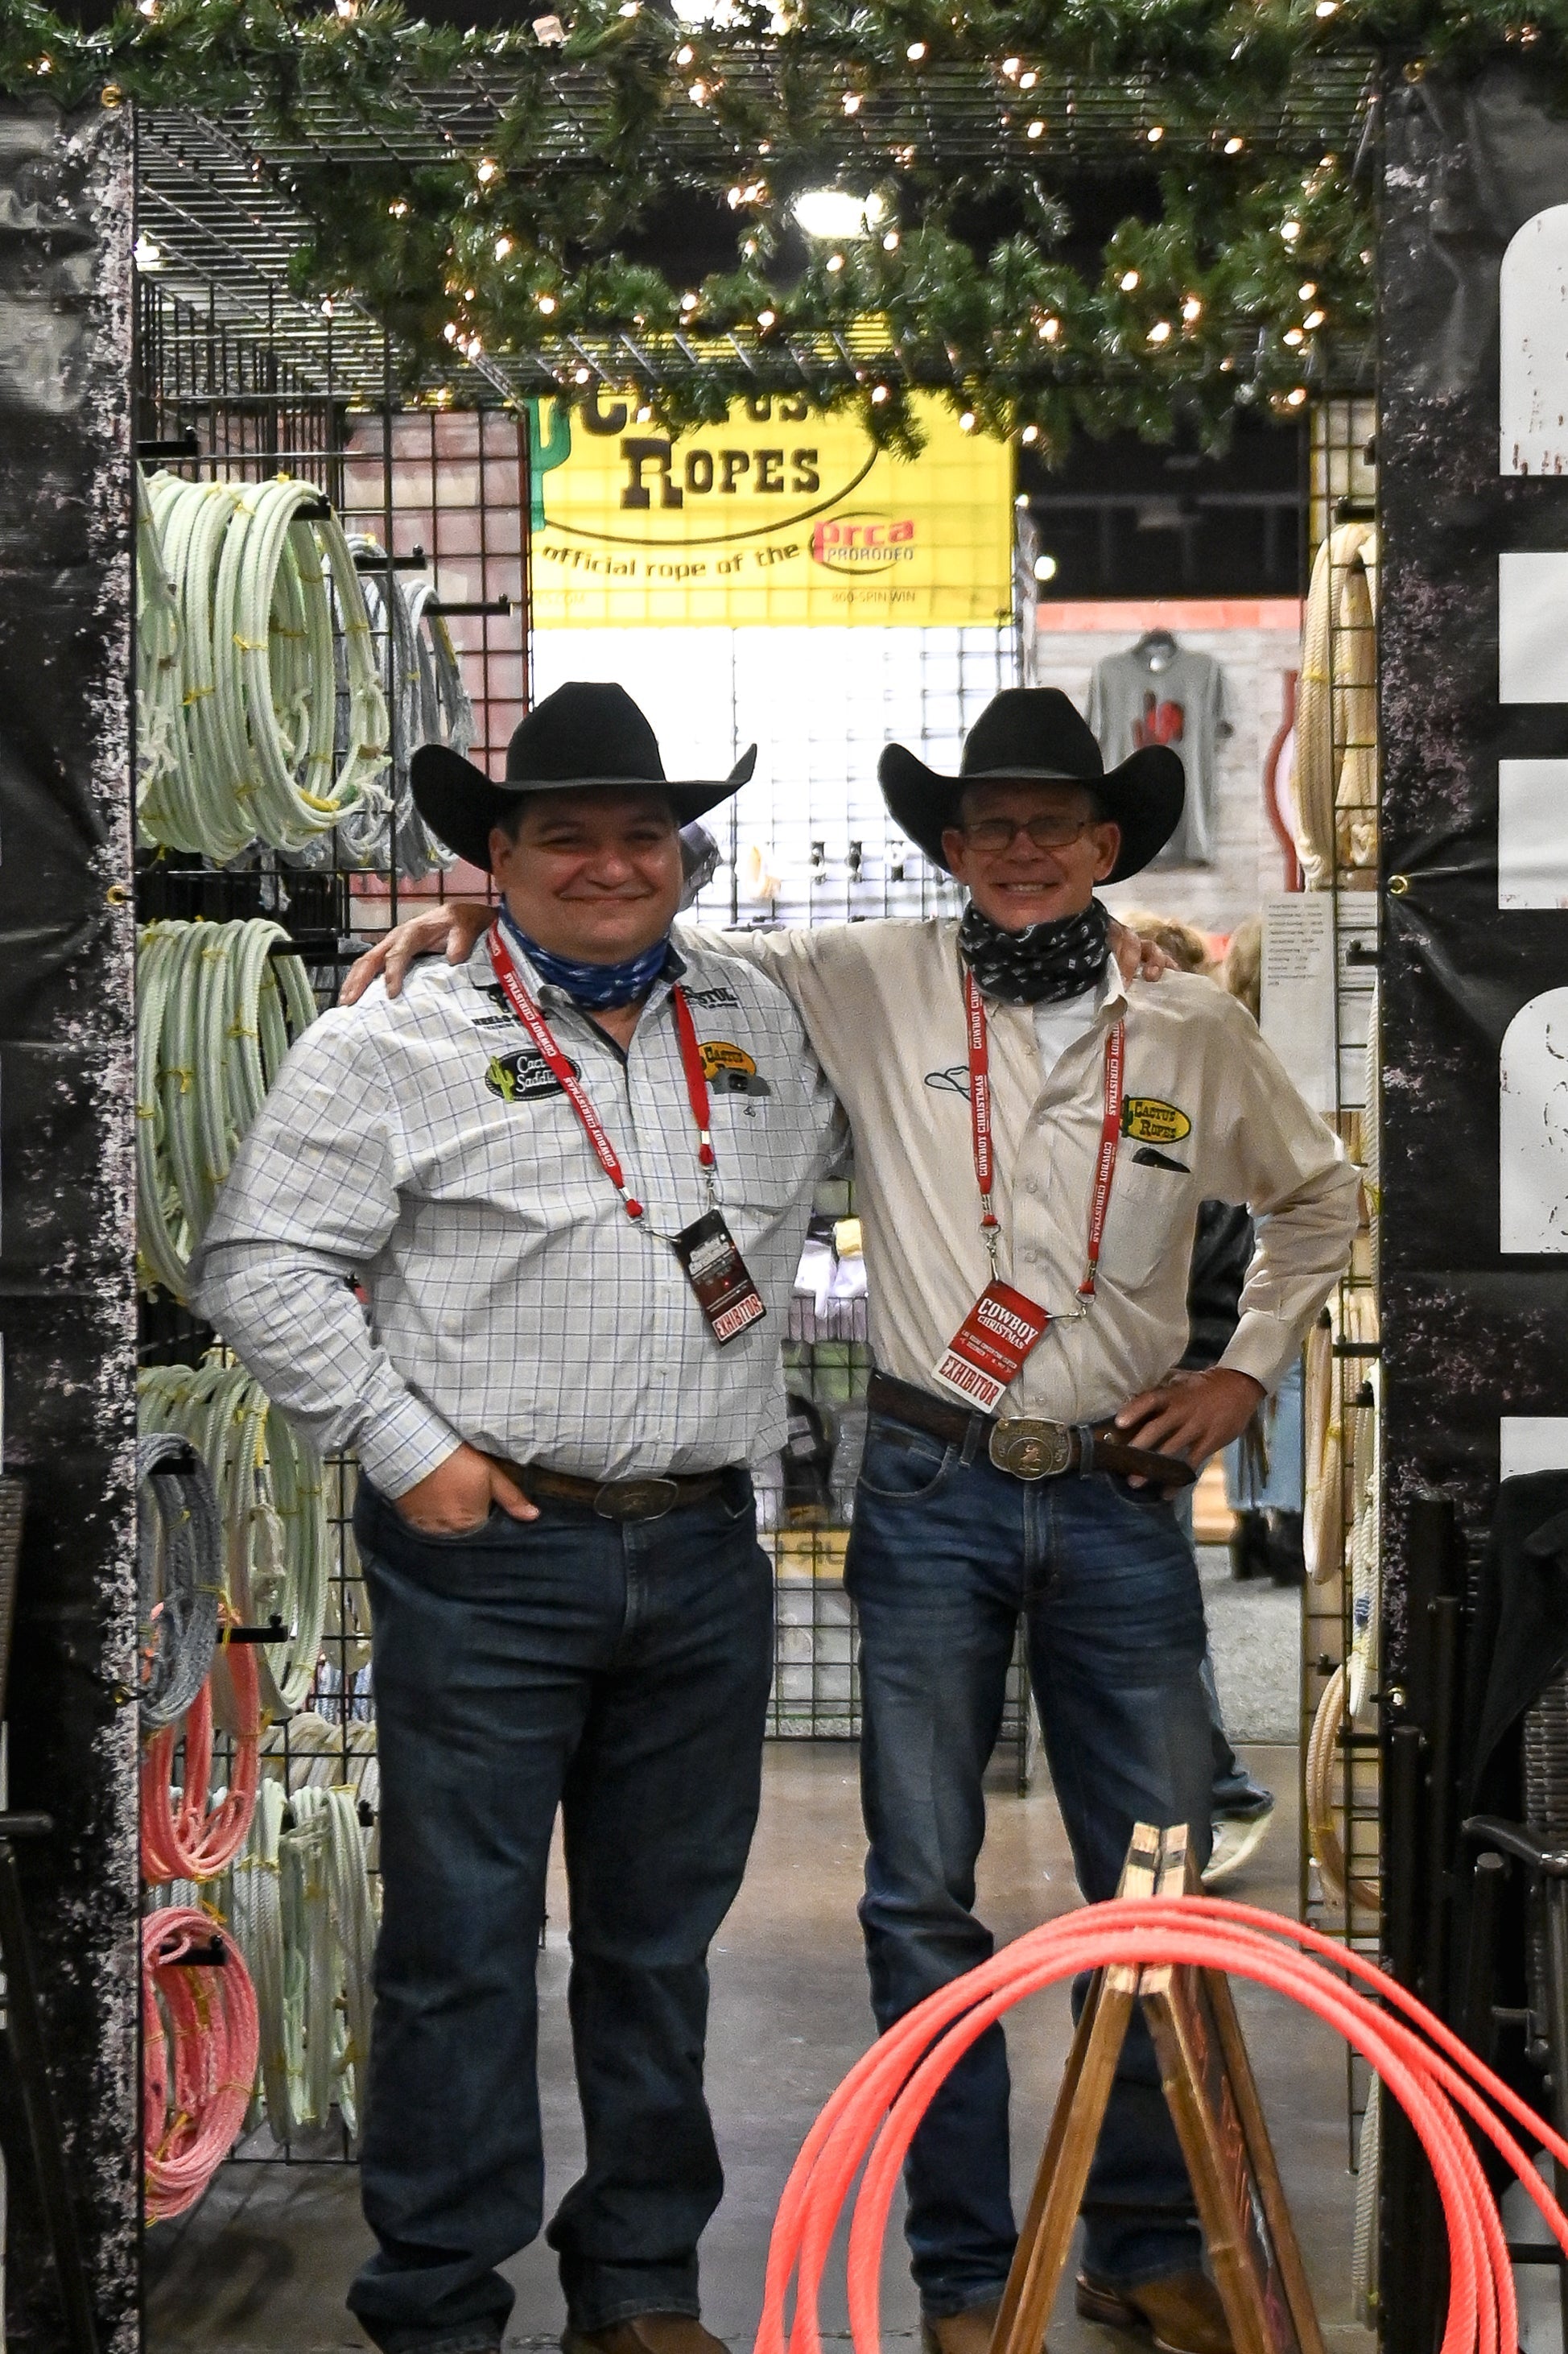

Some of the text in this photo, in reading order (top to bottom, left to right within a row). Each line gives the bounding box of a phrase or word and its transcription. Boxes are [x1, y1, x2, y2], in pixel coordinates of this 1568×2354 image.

[620, 437, 820, 510] ROPES
[542, 543, 801, 582] official rope of the
[814, 520, 914, 564] prca
[827, 547, 914, 561] PRORODEO
[502, 972, 557, 1057] COWBOY CHRISTMAS
[971, 1010, 982, 1050] COWBOY
[1108, 1059, 1119, 1117] CHRISTMAS
[563, 1076, 617, 1167] COWBOY CHRISTMAS
[974, 1075, 988, 1177] COWBOY CHRISTMAS
[1134, 1101, 1176, 1122] CACTUS
[1139, 1119, 1177, 1139] ROPES
[1092, 1142, 1112, 1243] COWBOY CHRISTMAS
[714, 1295, 761, 1338] EXHIBITOR
[976, 1315, 1026, 1350] CHRISTMAS
[977, 1298, 1039, 1346] COWBOY
[938, 1355, 1000, 1406] EXHIBITOR
